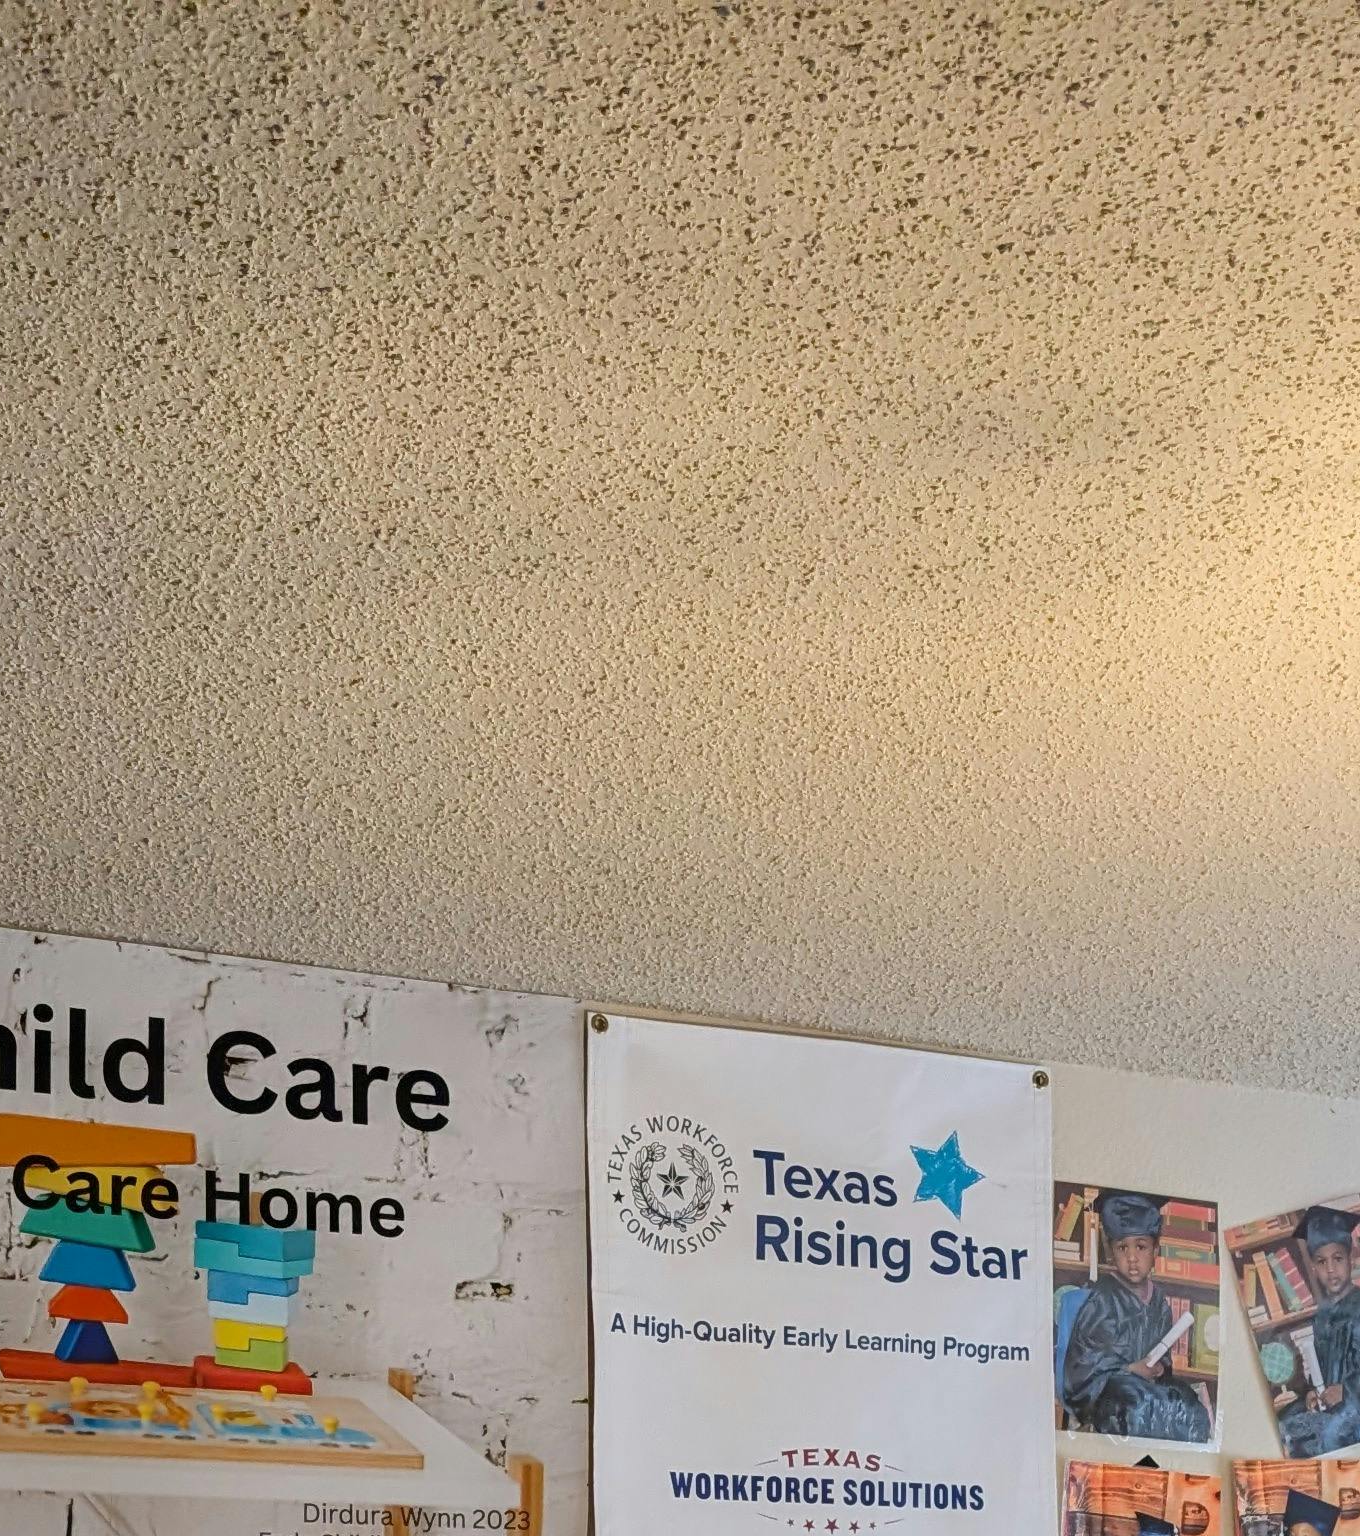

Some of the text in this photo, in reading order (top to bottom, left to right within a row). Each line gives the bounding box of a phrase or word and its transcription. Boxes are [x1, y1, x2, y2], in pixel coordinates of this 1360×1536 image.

[204, 1028, 452, 1137] Care
[607, 1115, 739, 1193] TEXAS WORKFORCE
[753, 1150, 898, 1207] Texas
[9, 1152, 180, 1220] Care
[203, 1171, 406, 1239] Home
[620, 1208, 727, 1254] COMMISSION
[755, 1216, 1028, 1283] Rising Star
[610, 1313, 1031, 1363] A High-Quality Early Learning Program
[782, 1448, 882, 1473] TEXAS
[304, 1502, 530, 1532] Dirdura Wynn 2023
[670, 1471, 985, 1511] WORKFORCE SOLUTIONS
